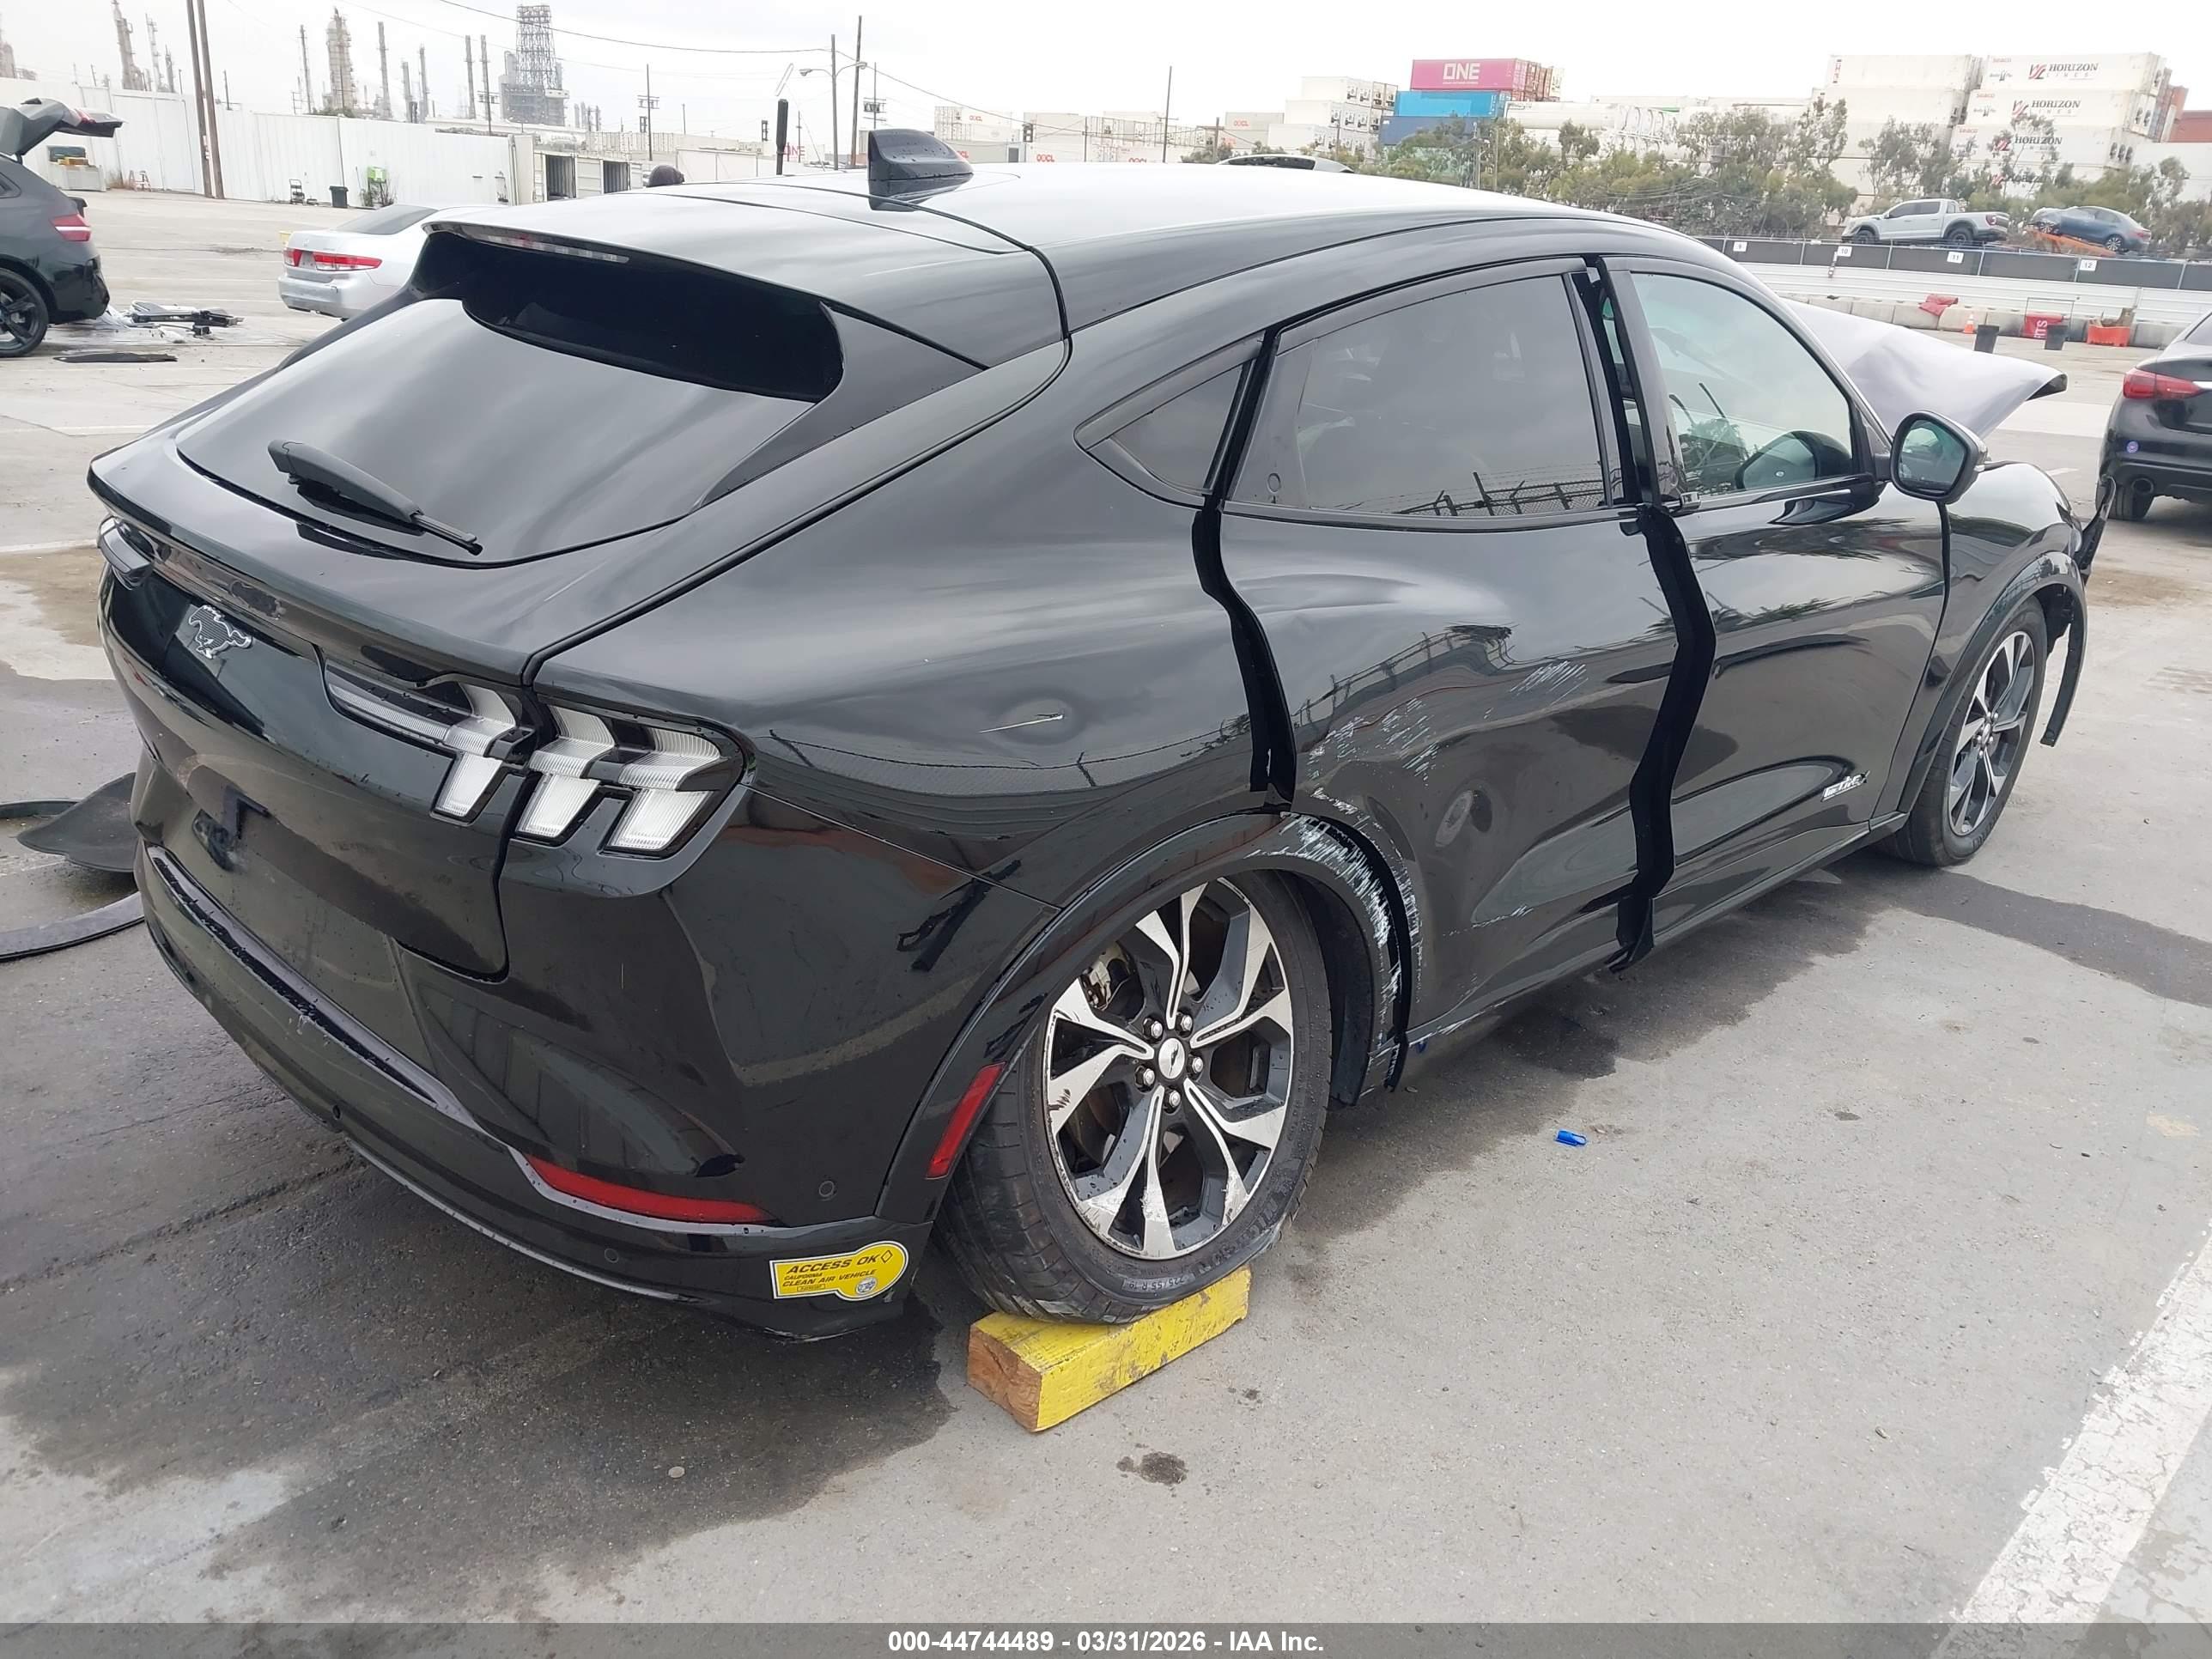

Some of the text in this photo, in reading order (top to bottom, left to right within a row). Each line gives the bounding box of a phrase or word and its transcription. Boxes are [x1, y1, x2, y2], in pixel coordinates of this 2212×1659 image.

[1443, 63, 1480, 80] ONE
[2049, 63, 2099, 71] HORIZON
[2032, 100, 2081, 108] HORIZON
[2014, 136, 2063, 145] HORIZON
[787, 1255, 879, 1274] ACCESS OK
[782, 1278, 817, 1287] CLEAN
[839, 1269, 877, 1280] VEHICLE
